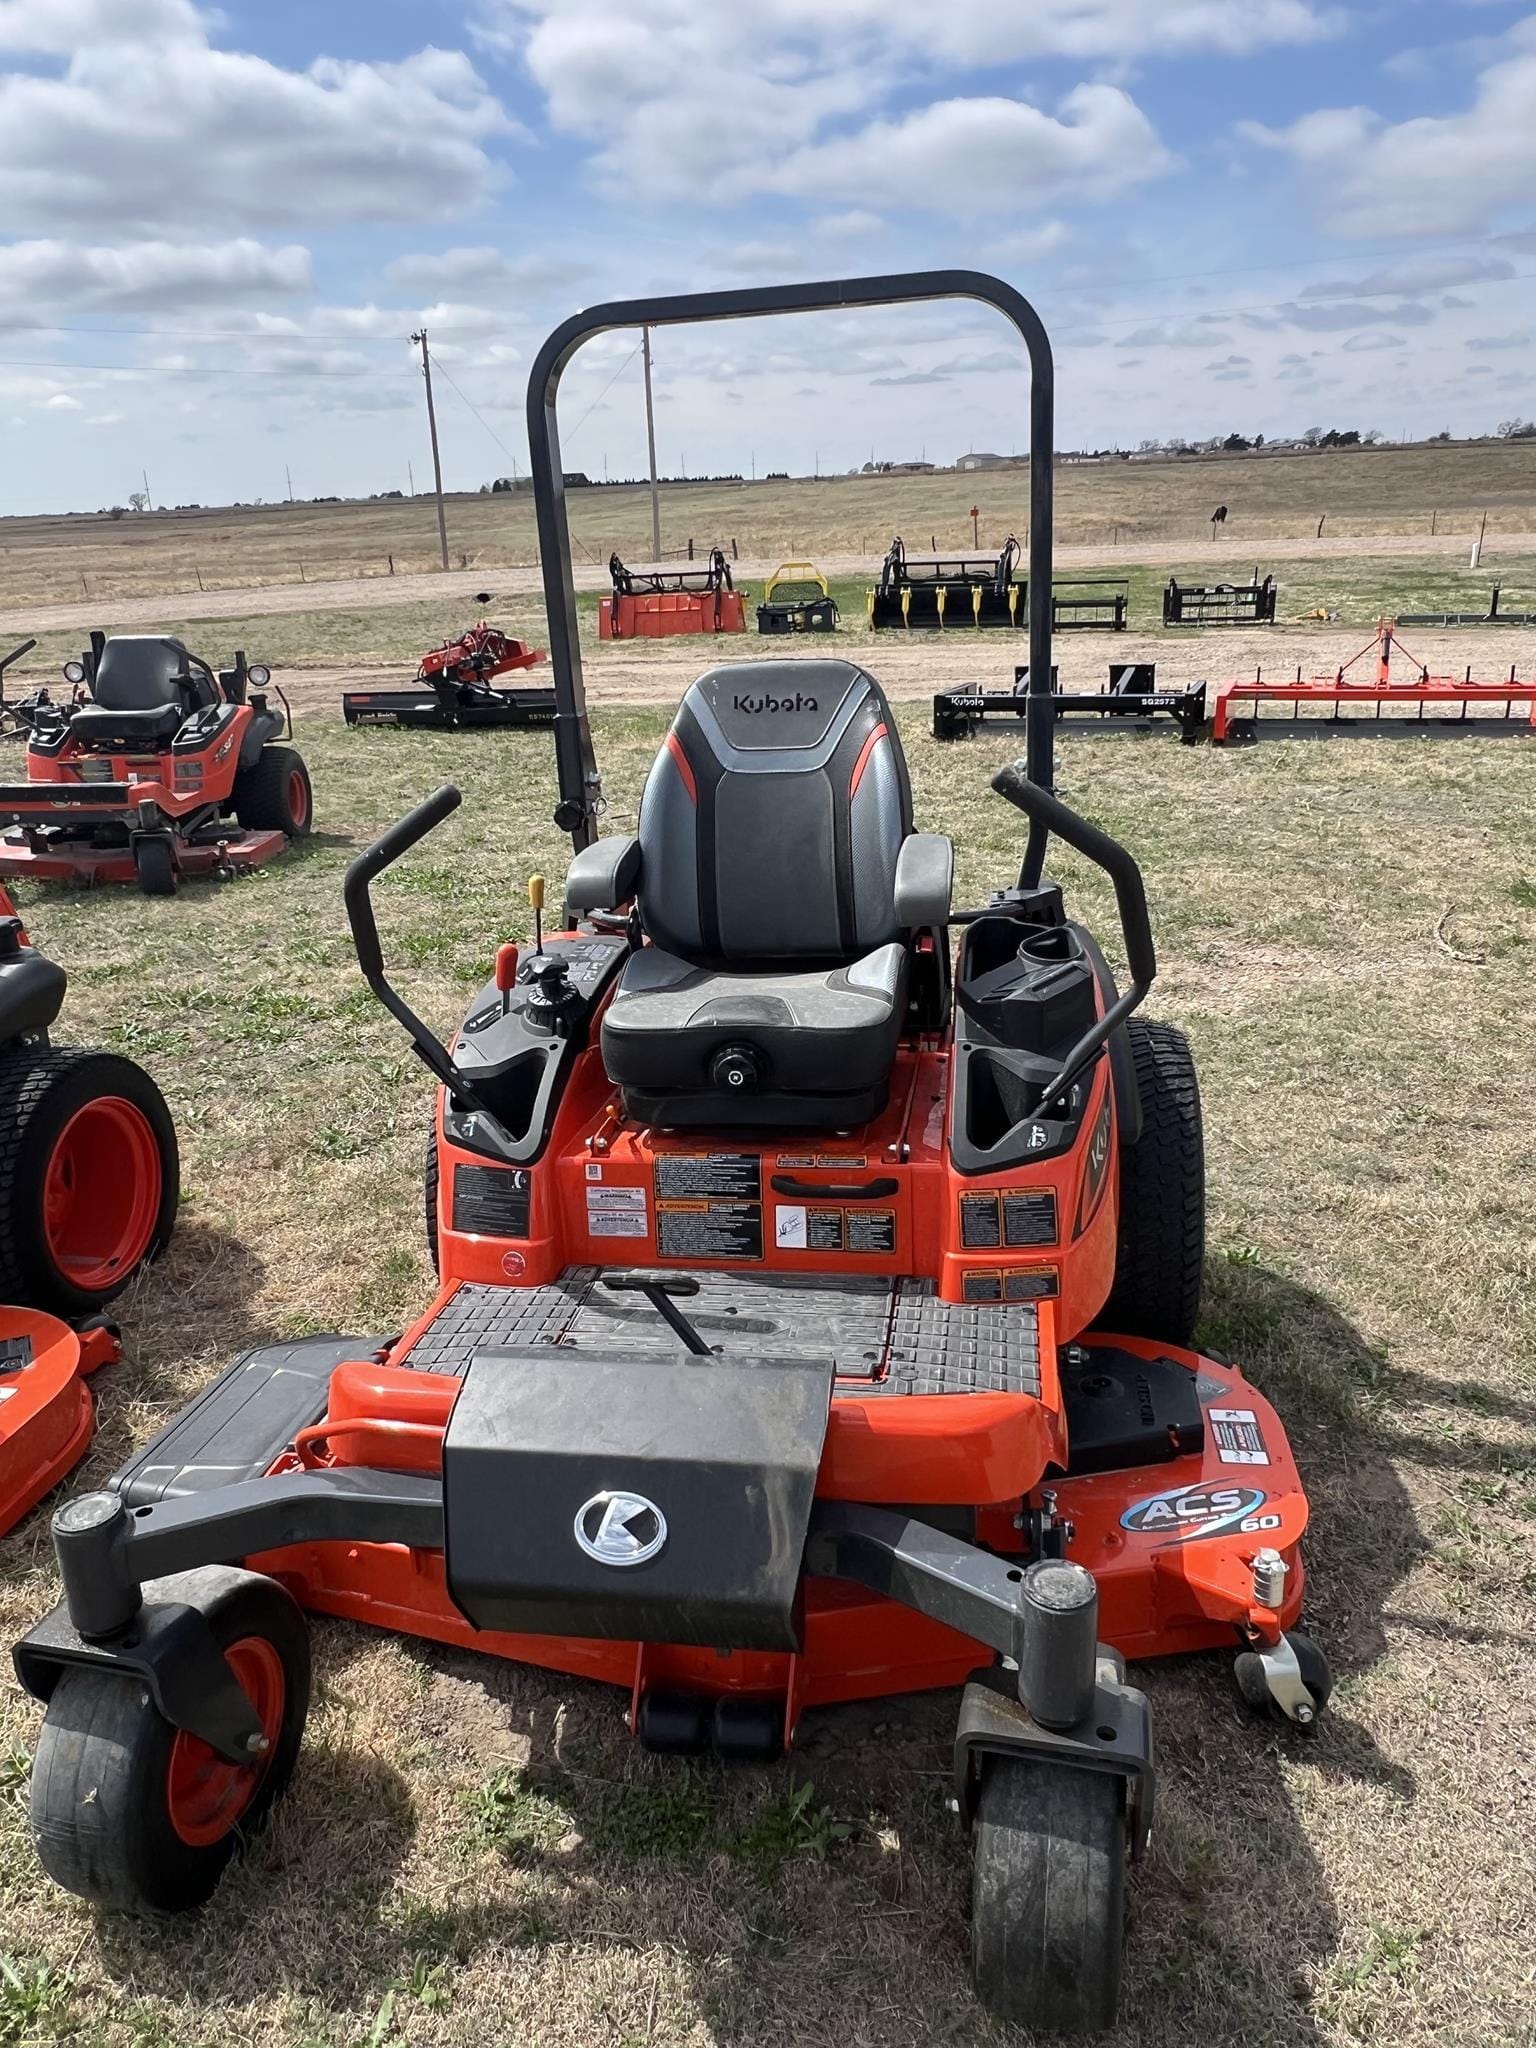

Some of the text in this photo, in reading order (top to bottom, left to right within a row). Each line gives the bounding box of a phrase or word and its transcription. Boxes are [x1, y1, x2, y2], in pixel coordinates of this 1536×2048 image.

[733, 692, 819, 714] Kubota
[951, 697, 984, 706] Kubota
[1142, 1489, 1242, 1523] ACS
[1240, 1515, 1280, 1532] 60
